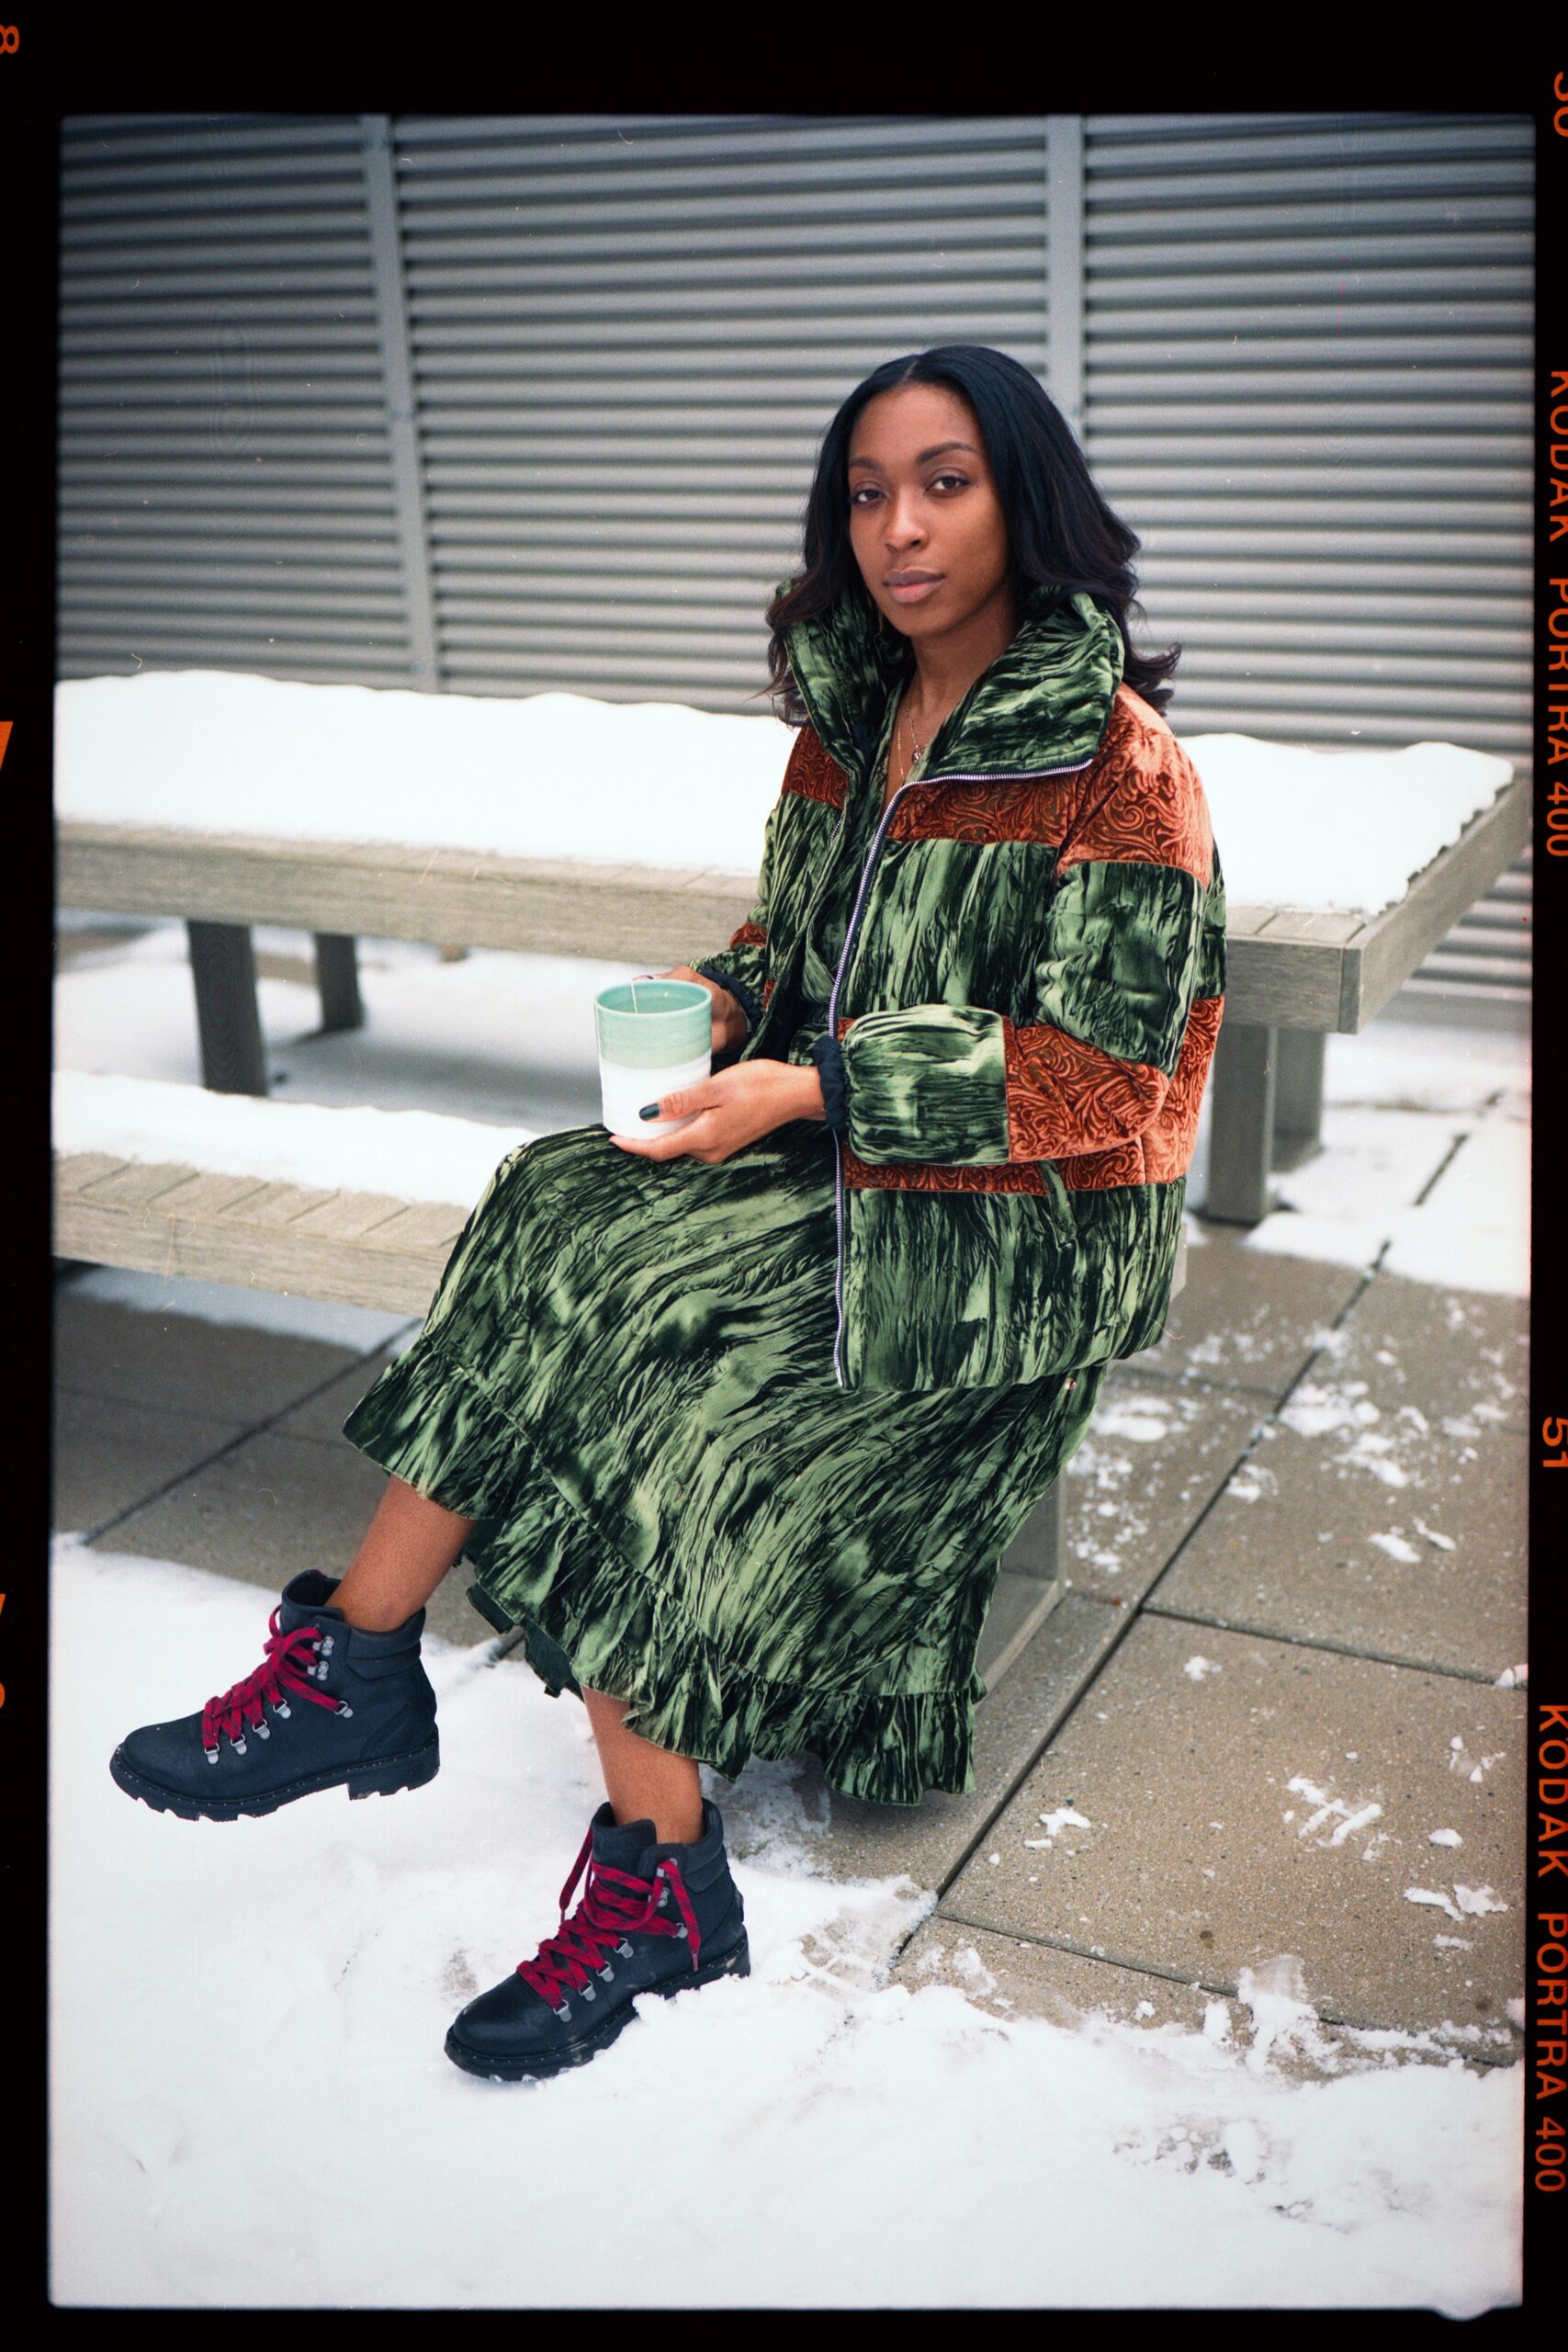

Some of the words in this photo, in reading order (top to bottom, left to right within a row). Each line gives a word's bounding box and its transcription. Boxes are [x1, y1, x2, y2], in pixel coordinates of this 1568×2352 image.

[1550, 370, 1568, 542] KODAK
[1548, 578, 1568, 765] PORTRA
[1547, 781, 1568, 857] 400
[1542, 1416, 1568, 1468] 51
[1538, 1704, 1568, 1877] KODAK
[1536, 1913, 1568, 2101] PORTRA
[1535, 2116, 1566, 2192] 400
